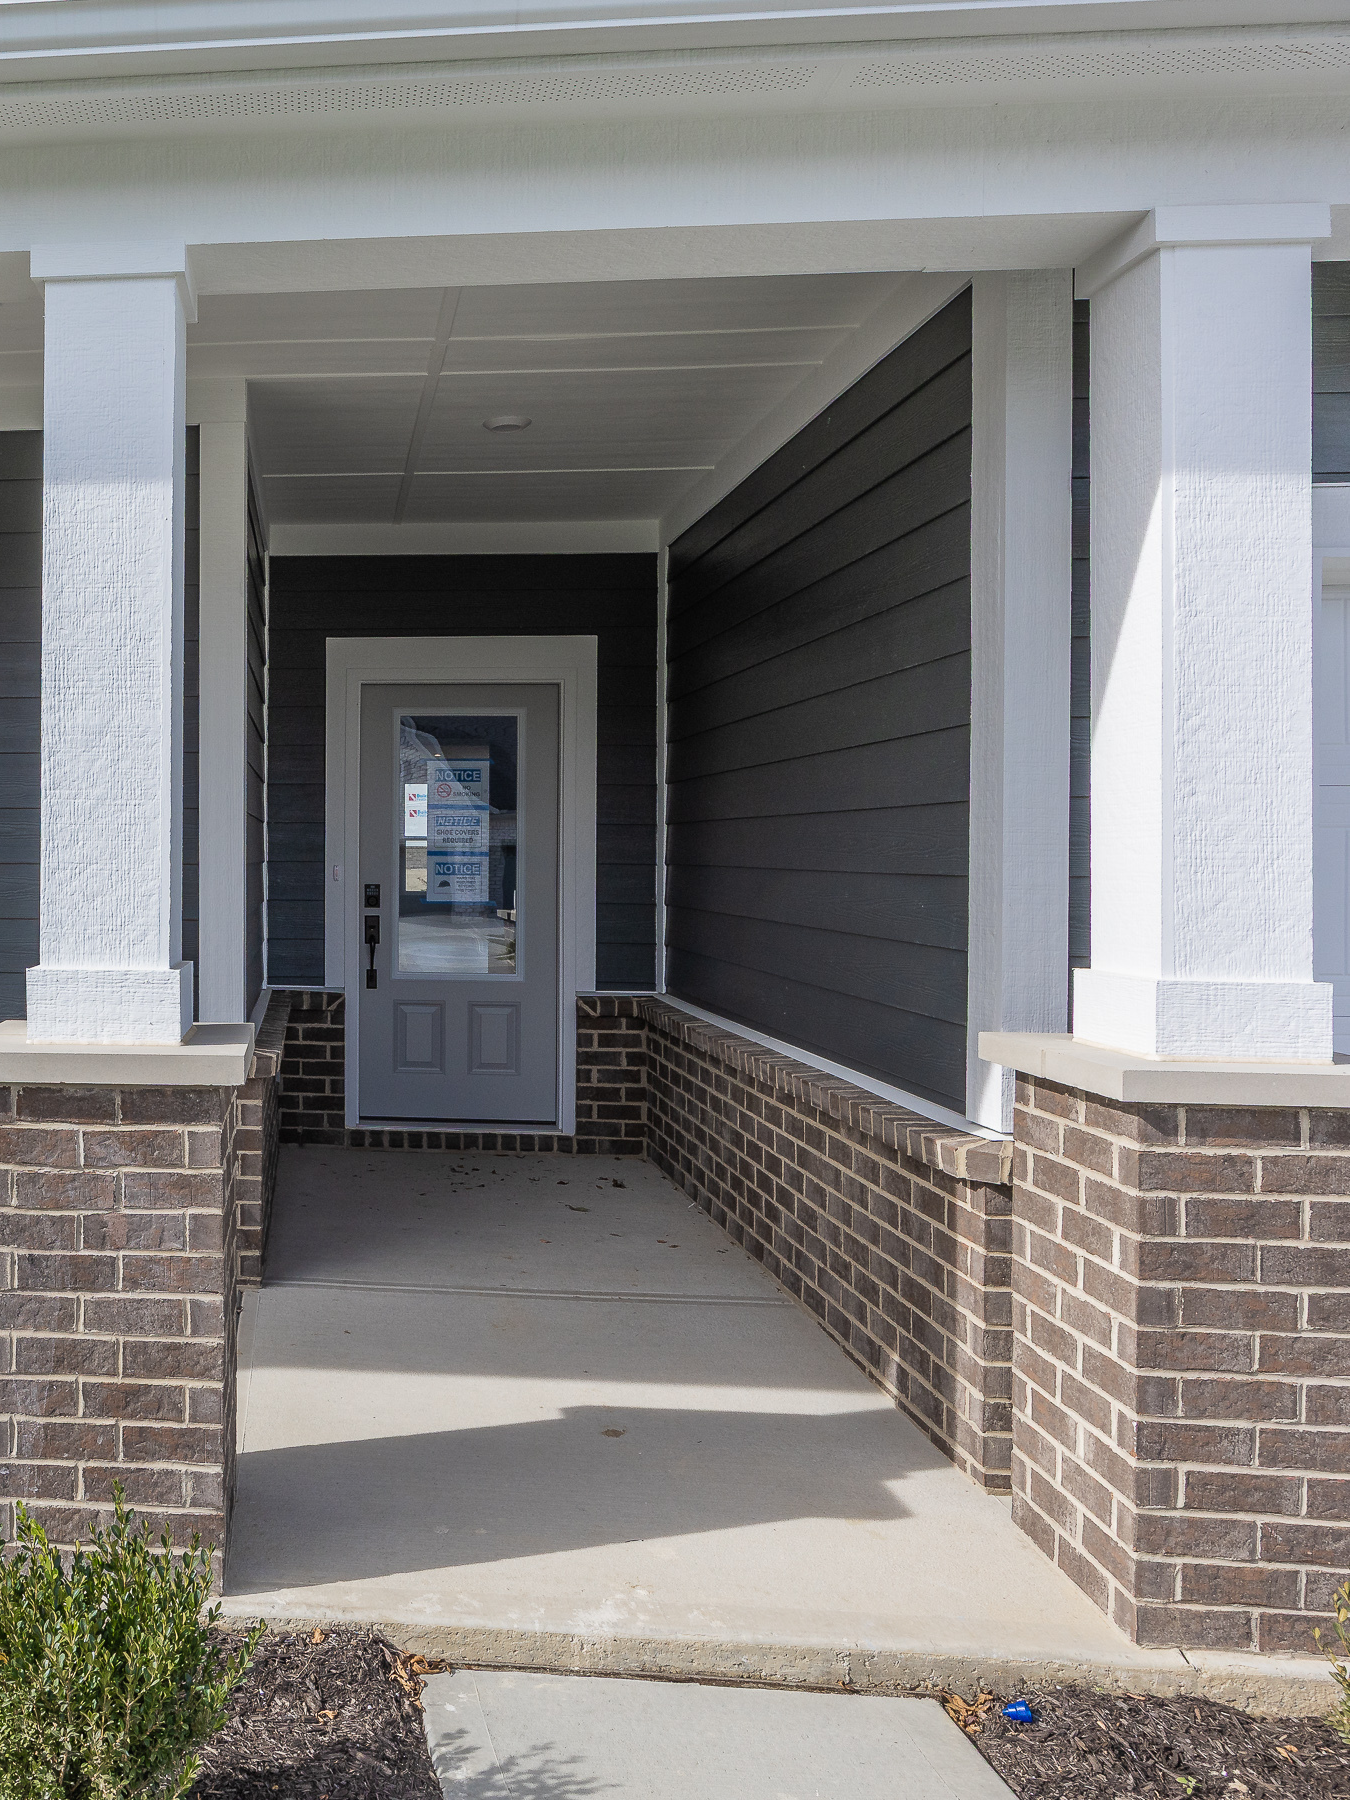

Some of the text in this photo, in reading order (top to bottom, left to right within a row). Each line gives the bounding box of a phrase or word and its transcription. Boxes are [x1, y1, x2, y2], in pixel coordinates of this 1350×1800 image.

[436, 770, 480, 780] NOTICE
[436, 817, 478, 826] NOTICE
[435, 864, 480, 874] NOTICE
